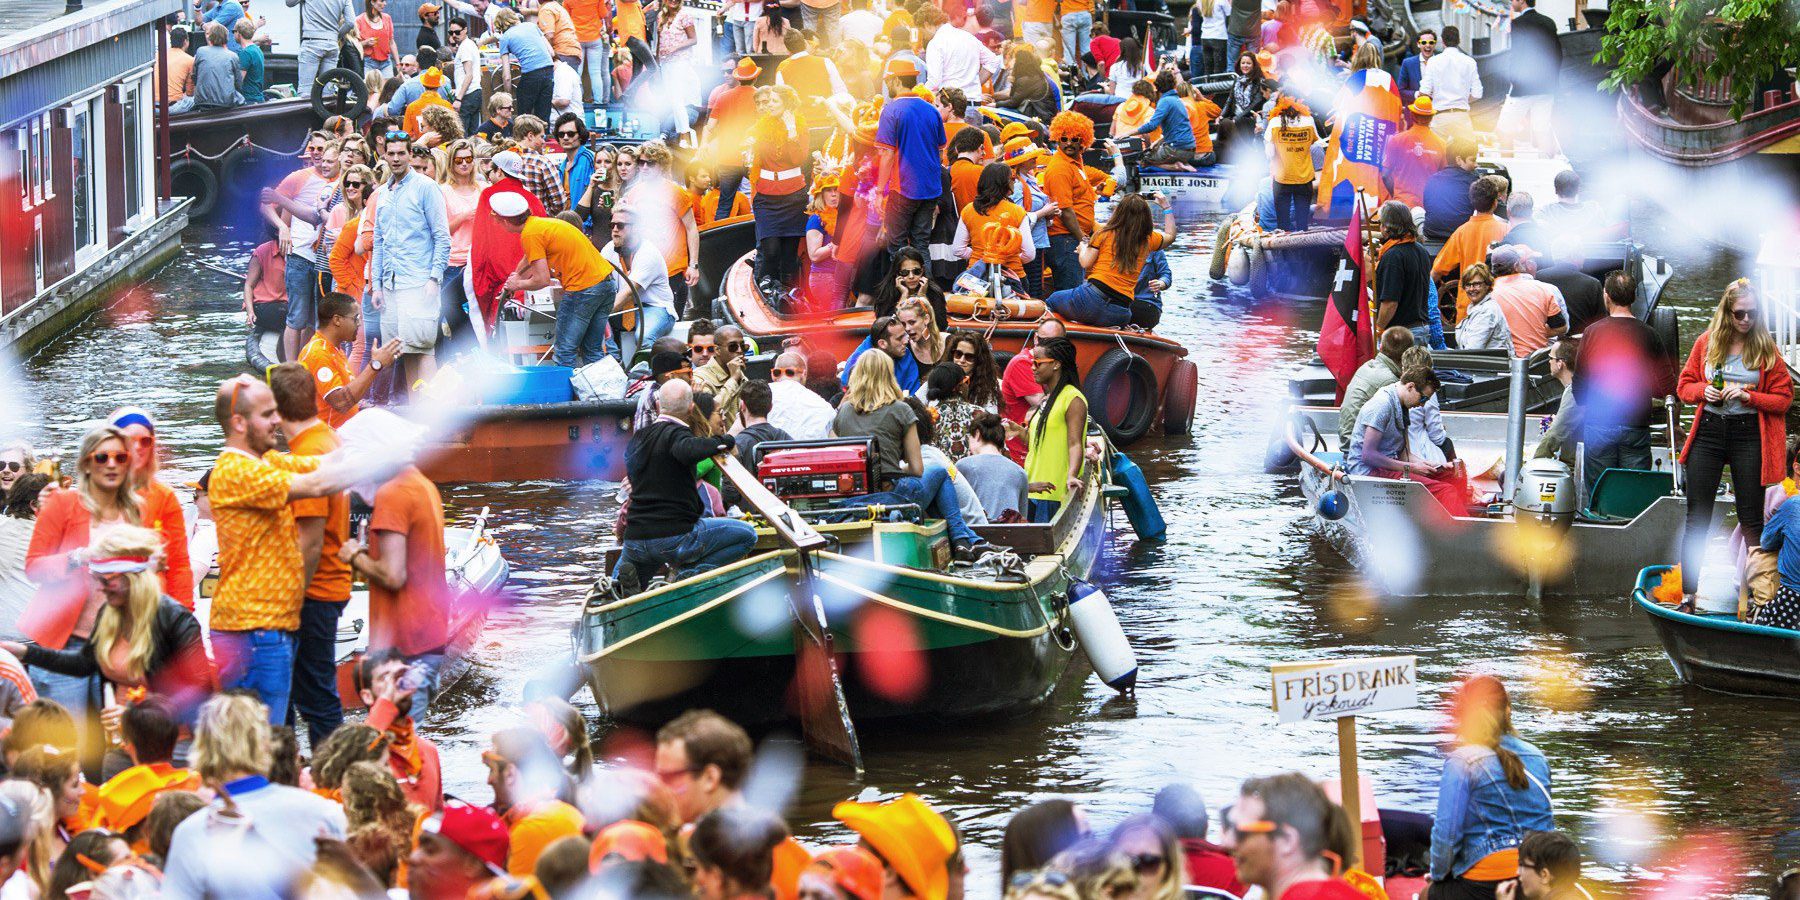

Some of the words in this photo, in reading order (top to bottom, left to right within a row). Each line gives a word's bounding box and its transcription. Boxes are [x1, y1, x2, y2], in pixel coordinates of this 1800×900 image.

[1356, 114, 1367, 160] ALEXANDER
[1363, 119, 1375, 161] WILLEM
[1142, 178, 1184, 186] MAGERE
[1187, 179, 1219, 188] JOSJE
[1539, 483, 1556, 492] 15
